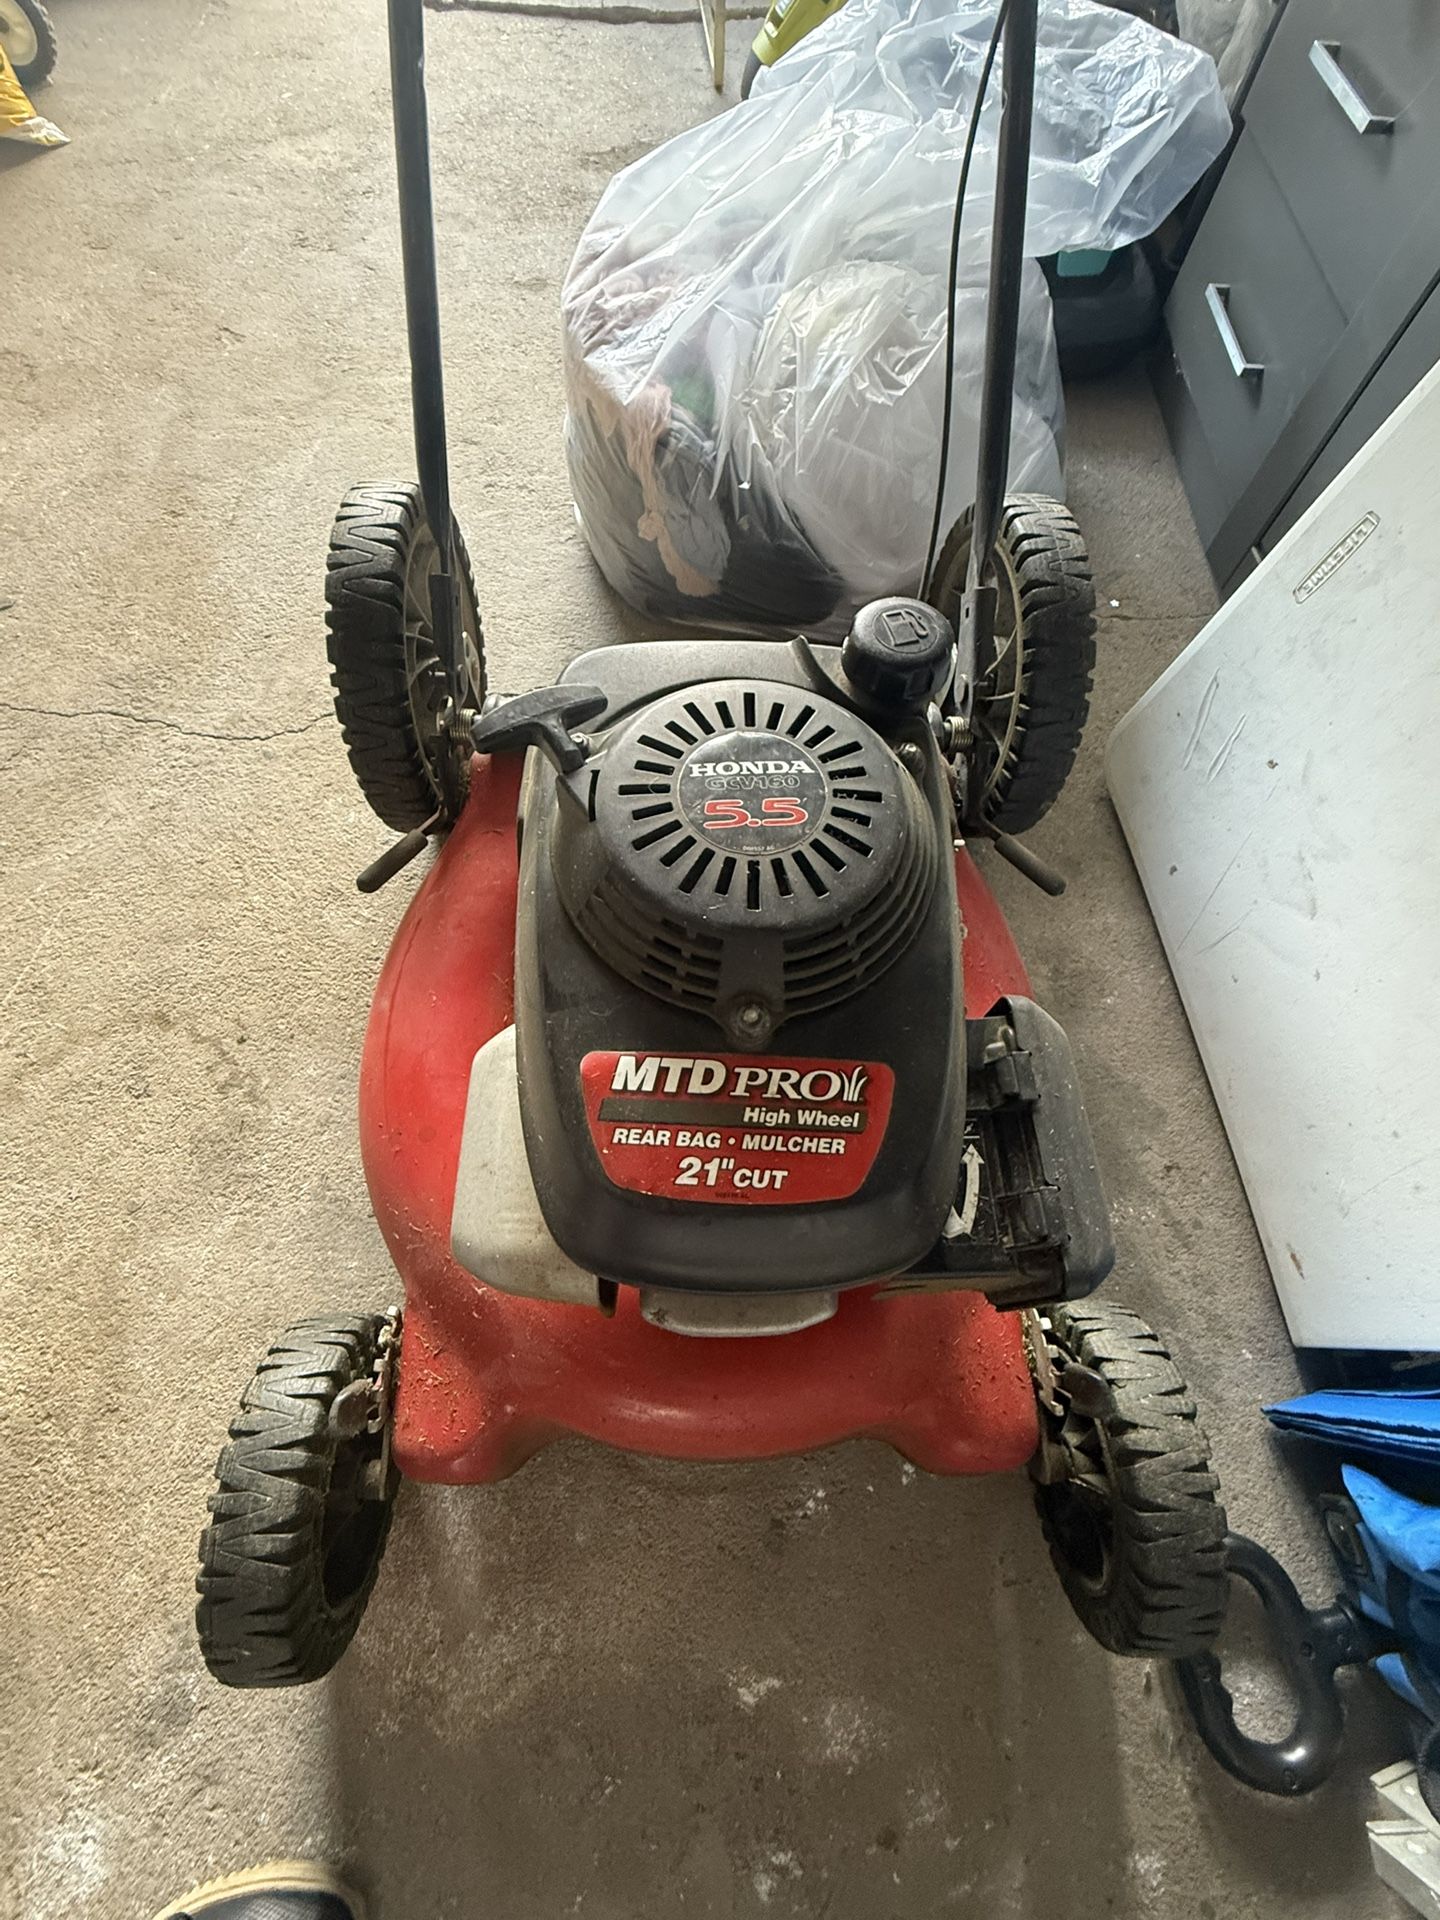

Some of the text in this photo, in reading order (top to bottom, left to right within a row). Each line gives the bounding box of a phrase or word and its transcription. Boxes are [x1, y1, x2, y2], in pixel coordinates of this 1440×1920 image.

[1302, 524, 1368, 594] LIFETIME
[689, 761, 815, 777] HONDA
[705, 775, 800, 790] GCV160
[703, 797, 808, 829] 5.5
[611, 1055, 842, 1101] MTD PRO
[743, 1107, 860, 1128] High Wheel
[612, 1128, 846, 1154] REAR BAG MULCHER
[674, 1156, 788, 1189] 21" CUT
